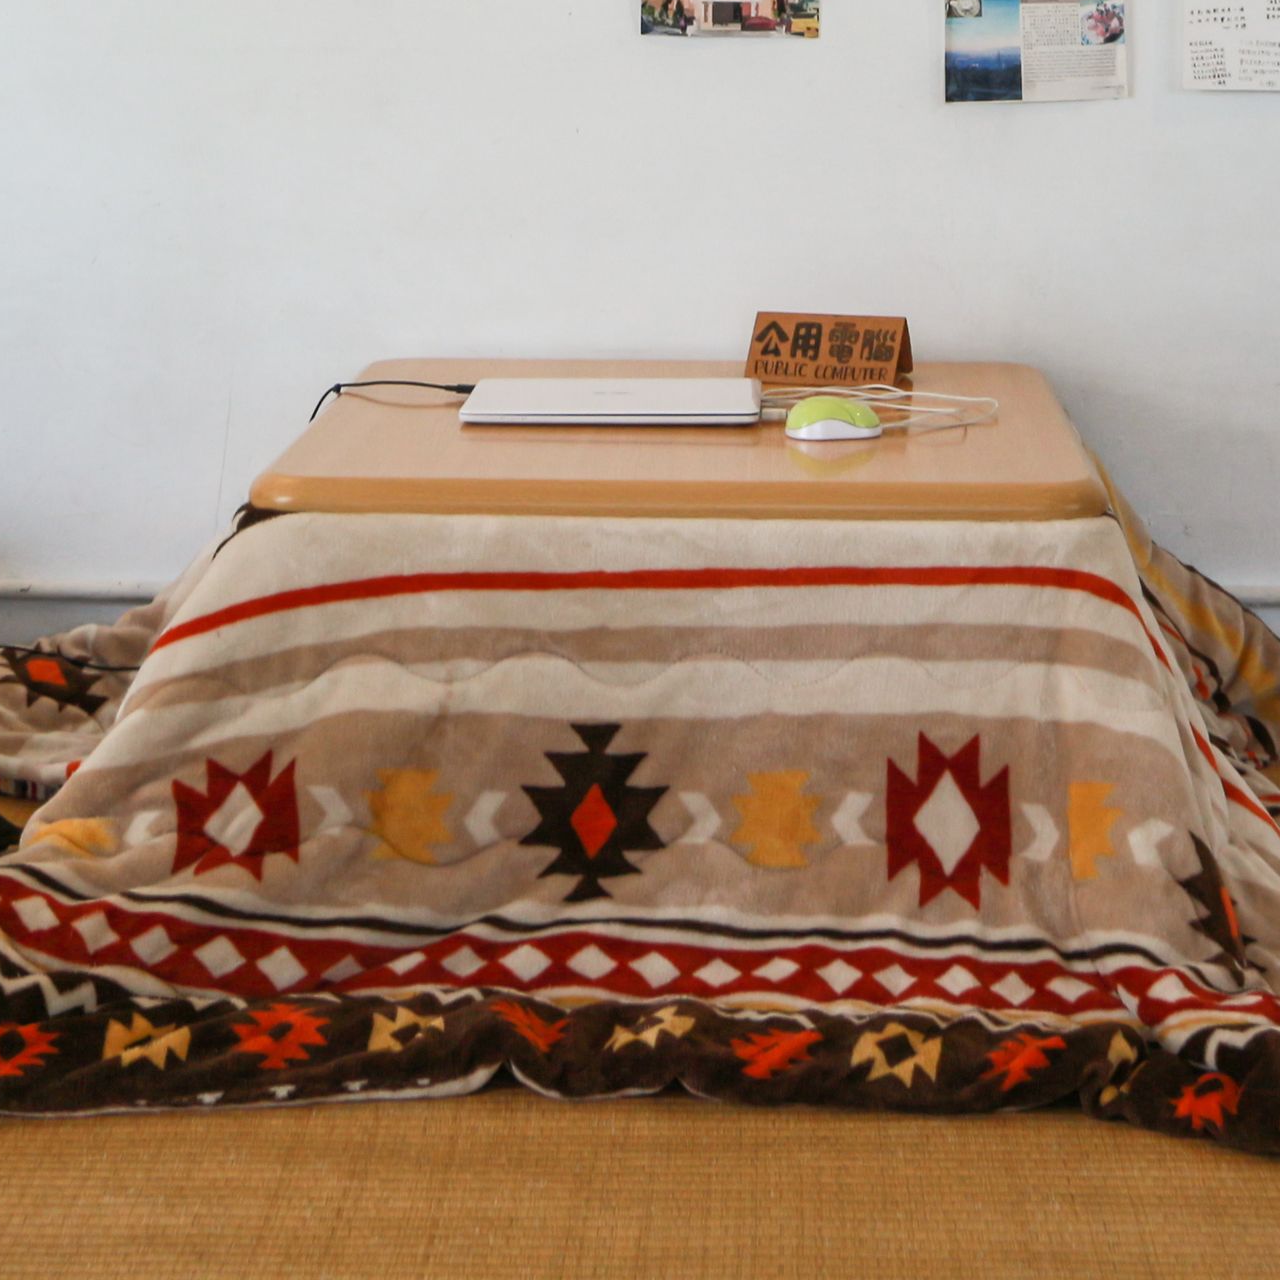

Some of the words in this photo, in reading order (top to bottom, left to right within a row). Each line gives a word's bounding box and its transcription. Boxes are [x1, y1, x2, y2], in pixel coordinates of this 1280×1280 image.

[754, 320, 897, 364] 公用電腦
[753, 359, 808, 378] PUBLIC
[813, 364, 889, 382] COMPUTER
